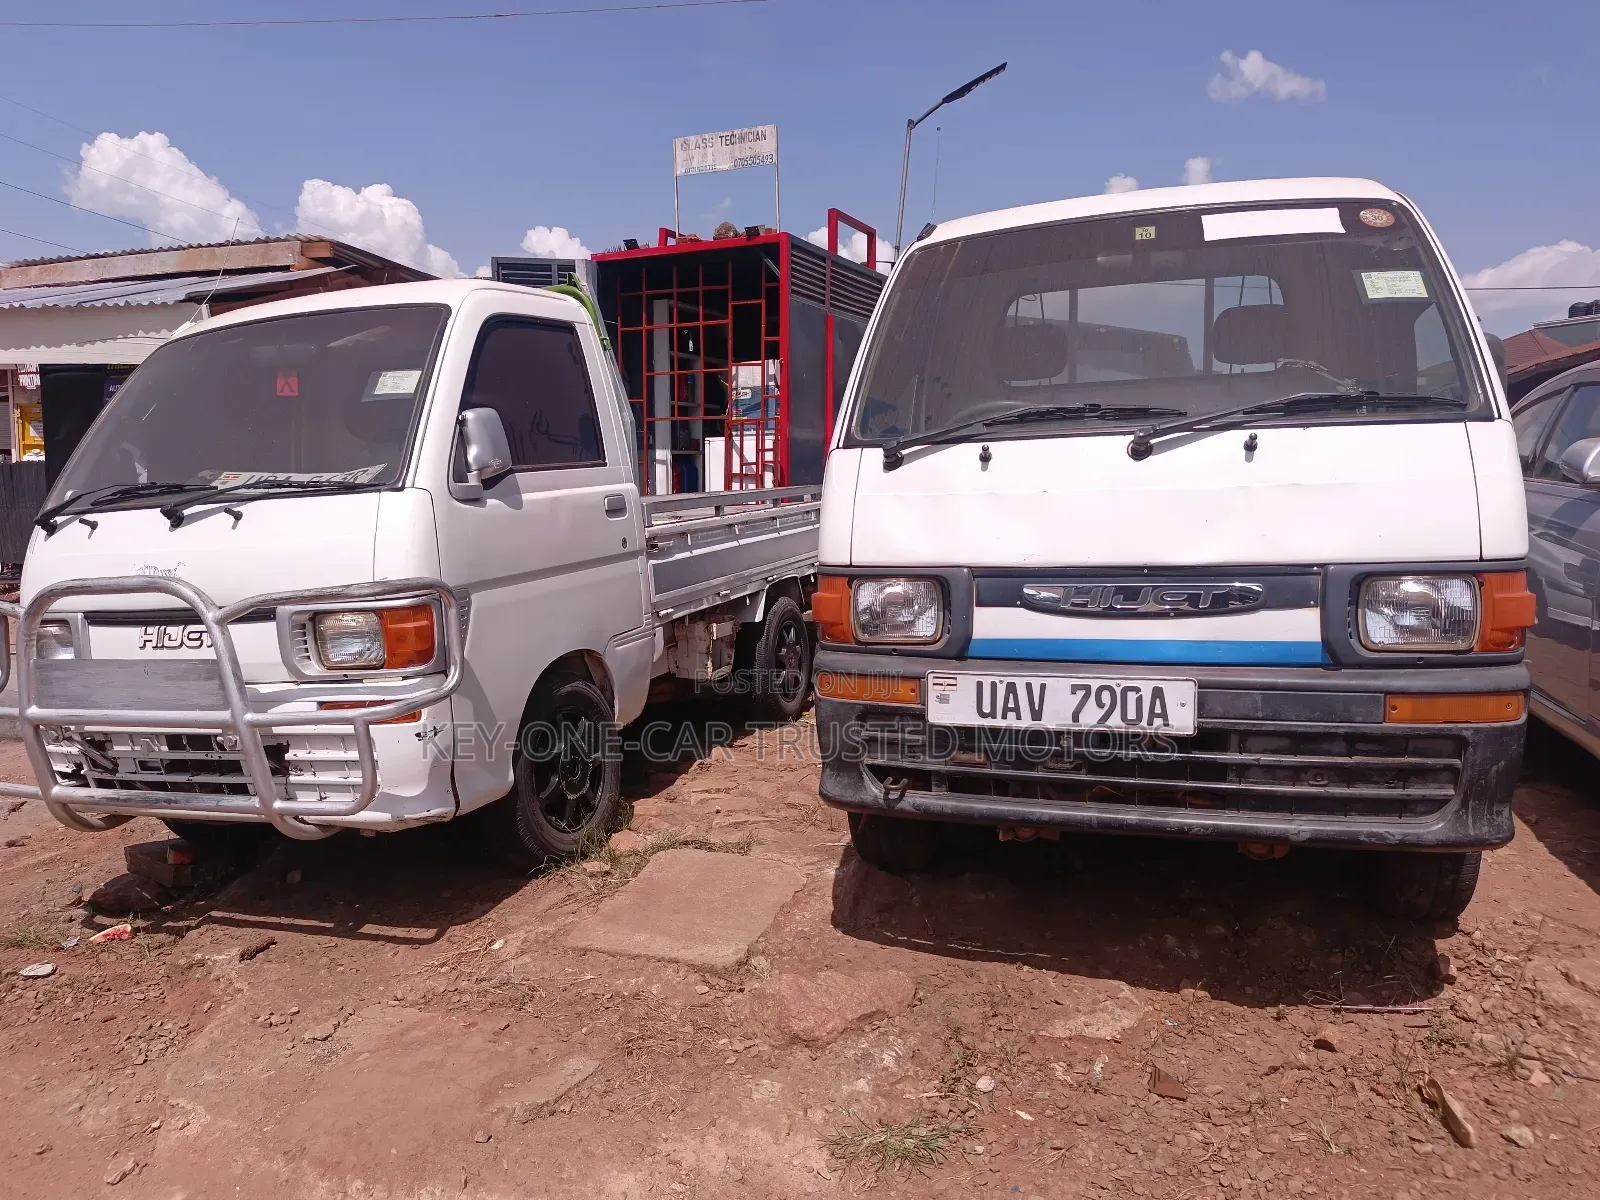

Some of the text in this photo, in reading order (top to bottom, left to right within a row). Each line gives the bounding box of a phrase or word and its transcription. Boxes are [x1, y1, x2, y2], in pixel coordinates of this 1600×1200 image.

[719, 129, 767, 147] TECHNICIAN
[109, 384, 123, 392] AUT
[976, 680, 1170, 728] UAV 790A
